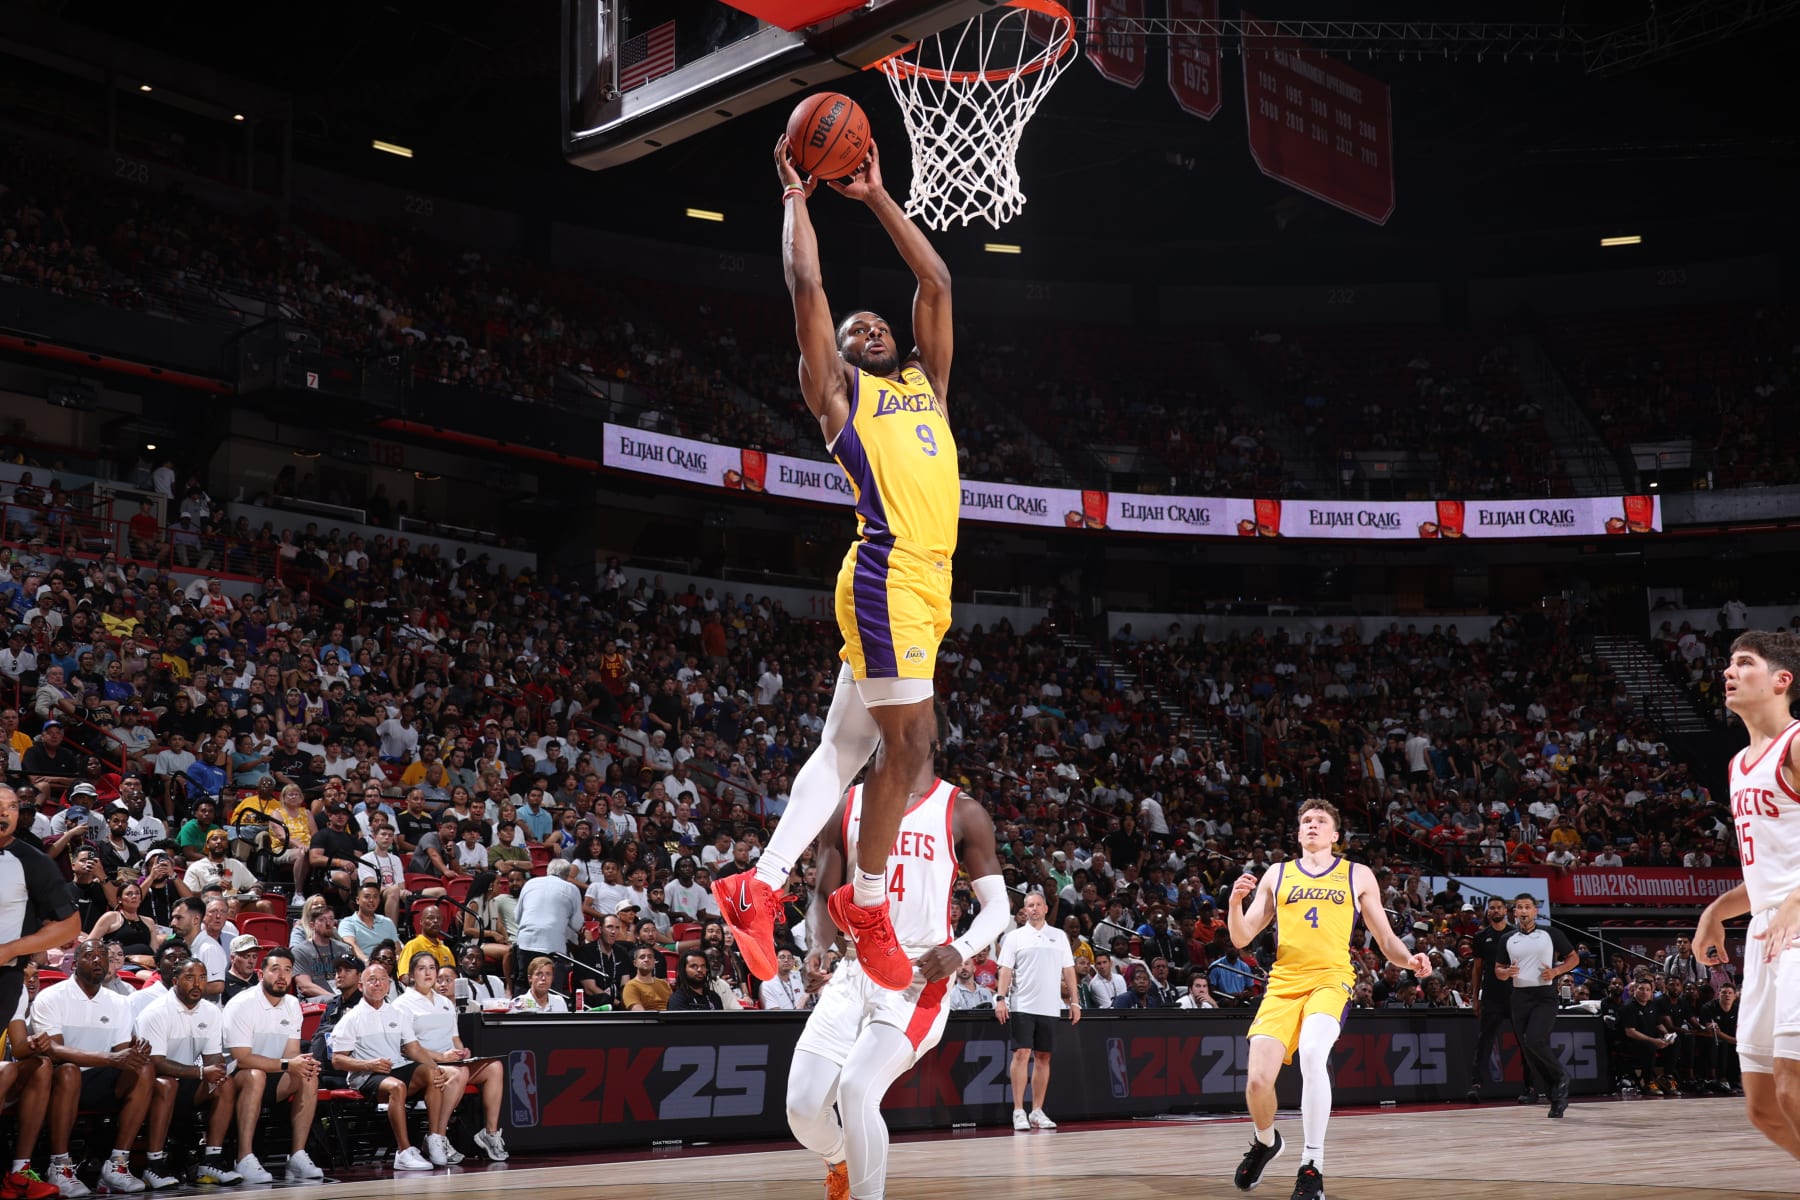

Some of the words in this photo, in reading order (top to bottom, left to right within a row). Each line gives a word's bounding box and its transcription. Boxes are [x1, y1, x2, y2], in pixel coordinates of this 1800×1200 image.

[1182, 60, 1209, 95] 1975
[809, 101, 846, 149] Wilson
[873, 389, 942, 418] LAKER
[620, 436, 663, 461] ELIJAH
[667, 446, 707, 470] CRAIG
[916, 424, 938, 456] 9
[779, 465, 821, 488] ELIJAH
[824, 473, 853, 493] CRA
[961, 489, 1003, 510] ELIJAH
[1007, 494, 1047, 514] CRAIG
[1121, 502, 1164, 521] ELIJAH
[1168, 505, 1210, 523] CRAIG
[1309, 509, 1354, 528] ELIJAH
[1357, 510, 1400, 528] CRAIG
[1479, 509, 1525, 527] ELIJAH
[1529, 508, 1574, 526] CRAIG
[1731, 788, 1780, 819] CKETS
[886, 864, 905, 902] 4
[1285, 886, 1346, 904] LAKERS
[1304, 907, 1318, 928] 4
[1334, 1033, 1447, 1088] 2K25
[542, 1044, 769, 1127] 2K25
